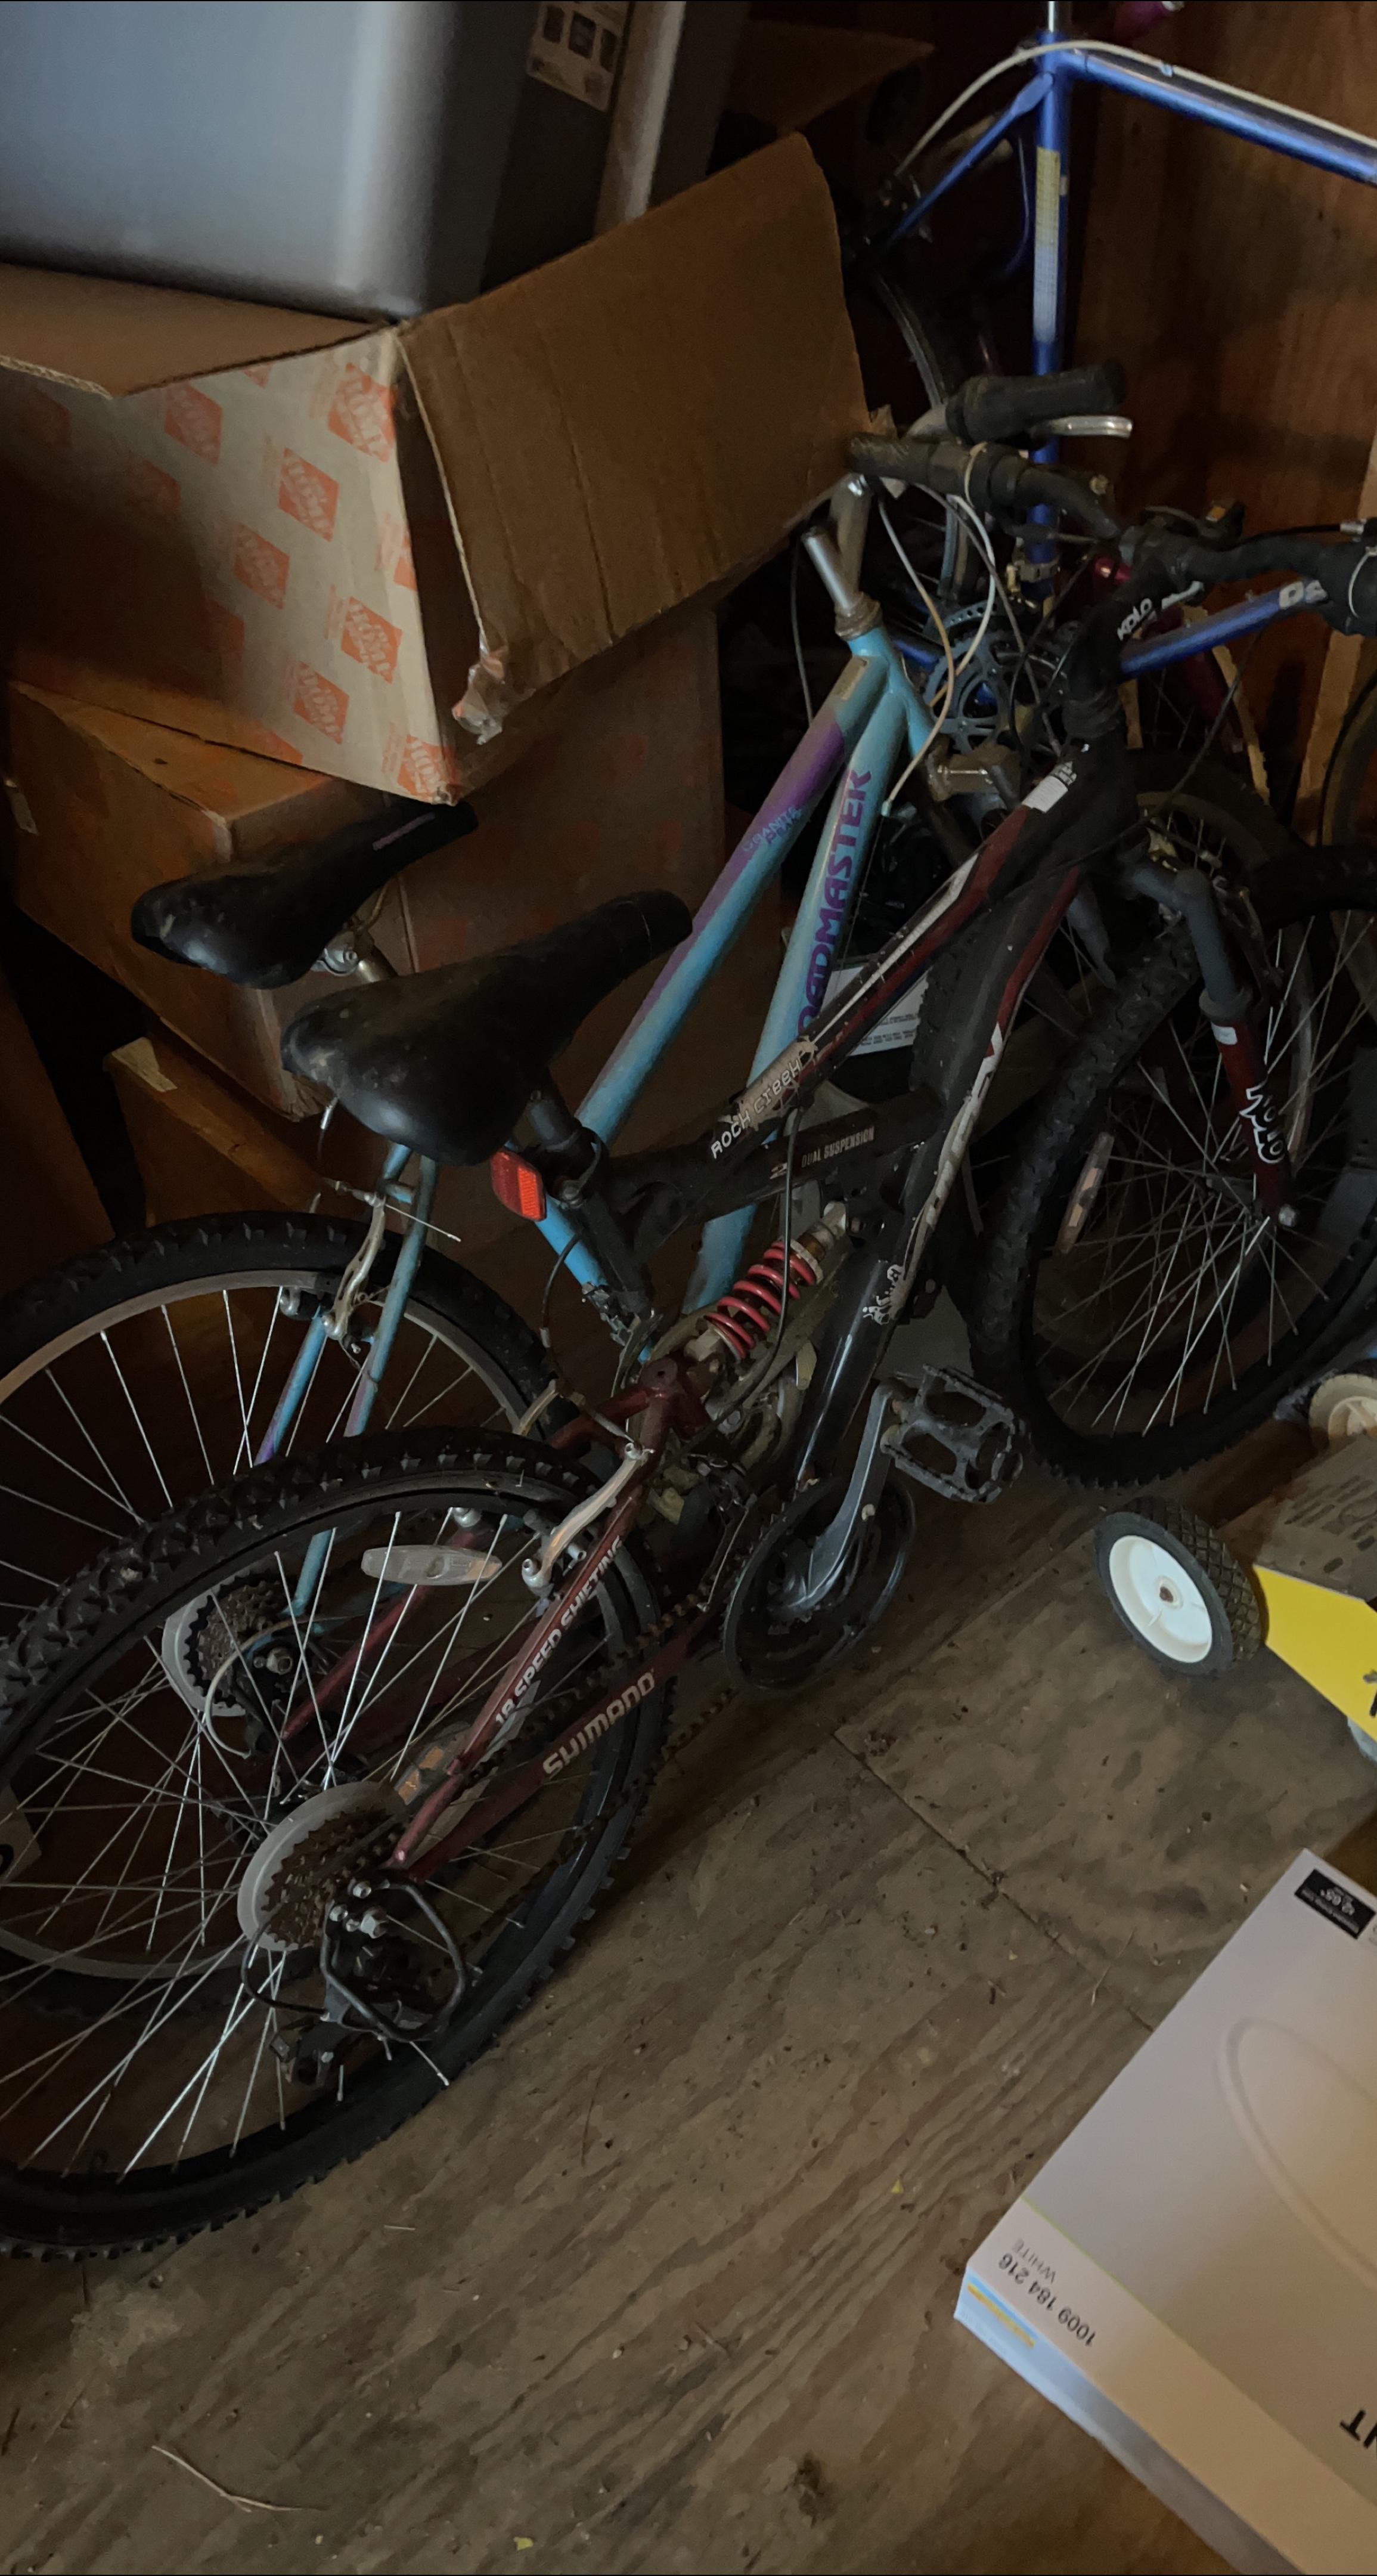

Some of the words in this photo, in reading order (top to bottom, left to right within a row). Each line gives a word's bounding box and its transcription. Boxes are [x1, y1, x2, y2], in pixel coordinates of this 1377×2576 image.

[798, 770, 872, 1036] OADMASTER
[824, 1125, 874, 1159] SUSPENSION
[514, 1628, 562, 1697] SPEED
[542, 1671, 655, 1775] SHIMANO
[998, 2253, 1029, 2284] 216
[1028, 2280, 1057, 2311] 184
[1057, 2306, 1096, 2347] 1009
